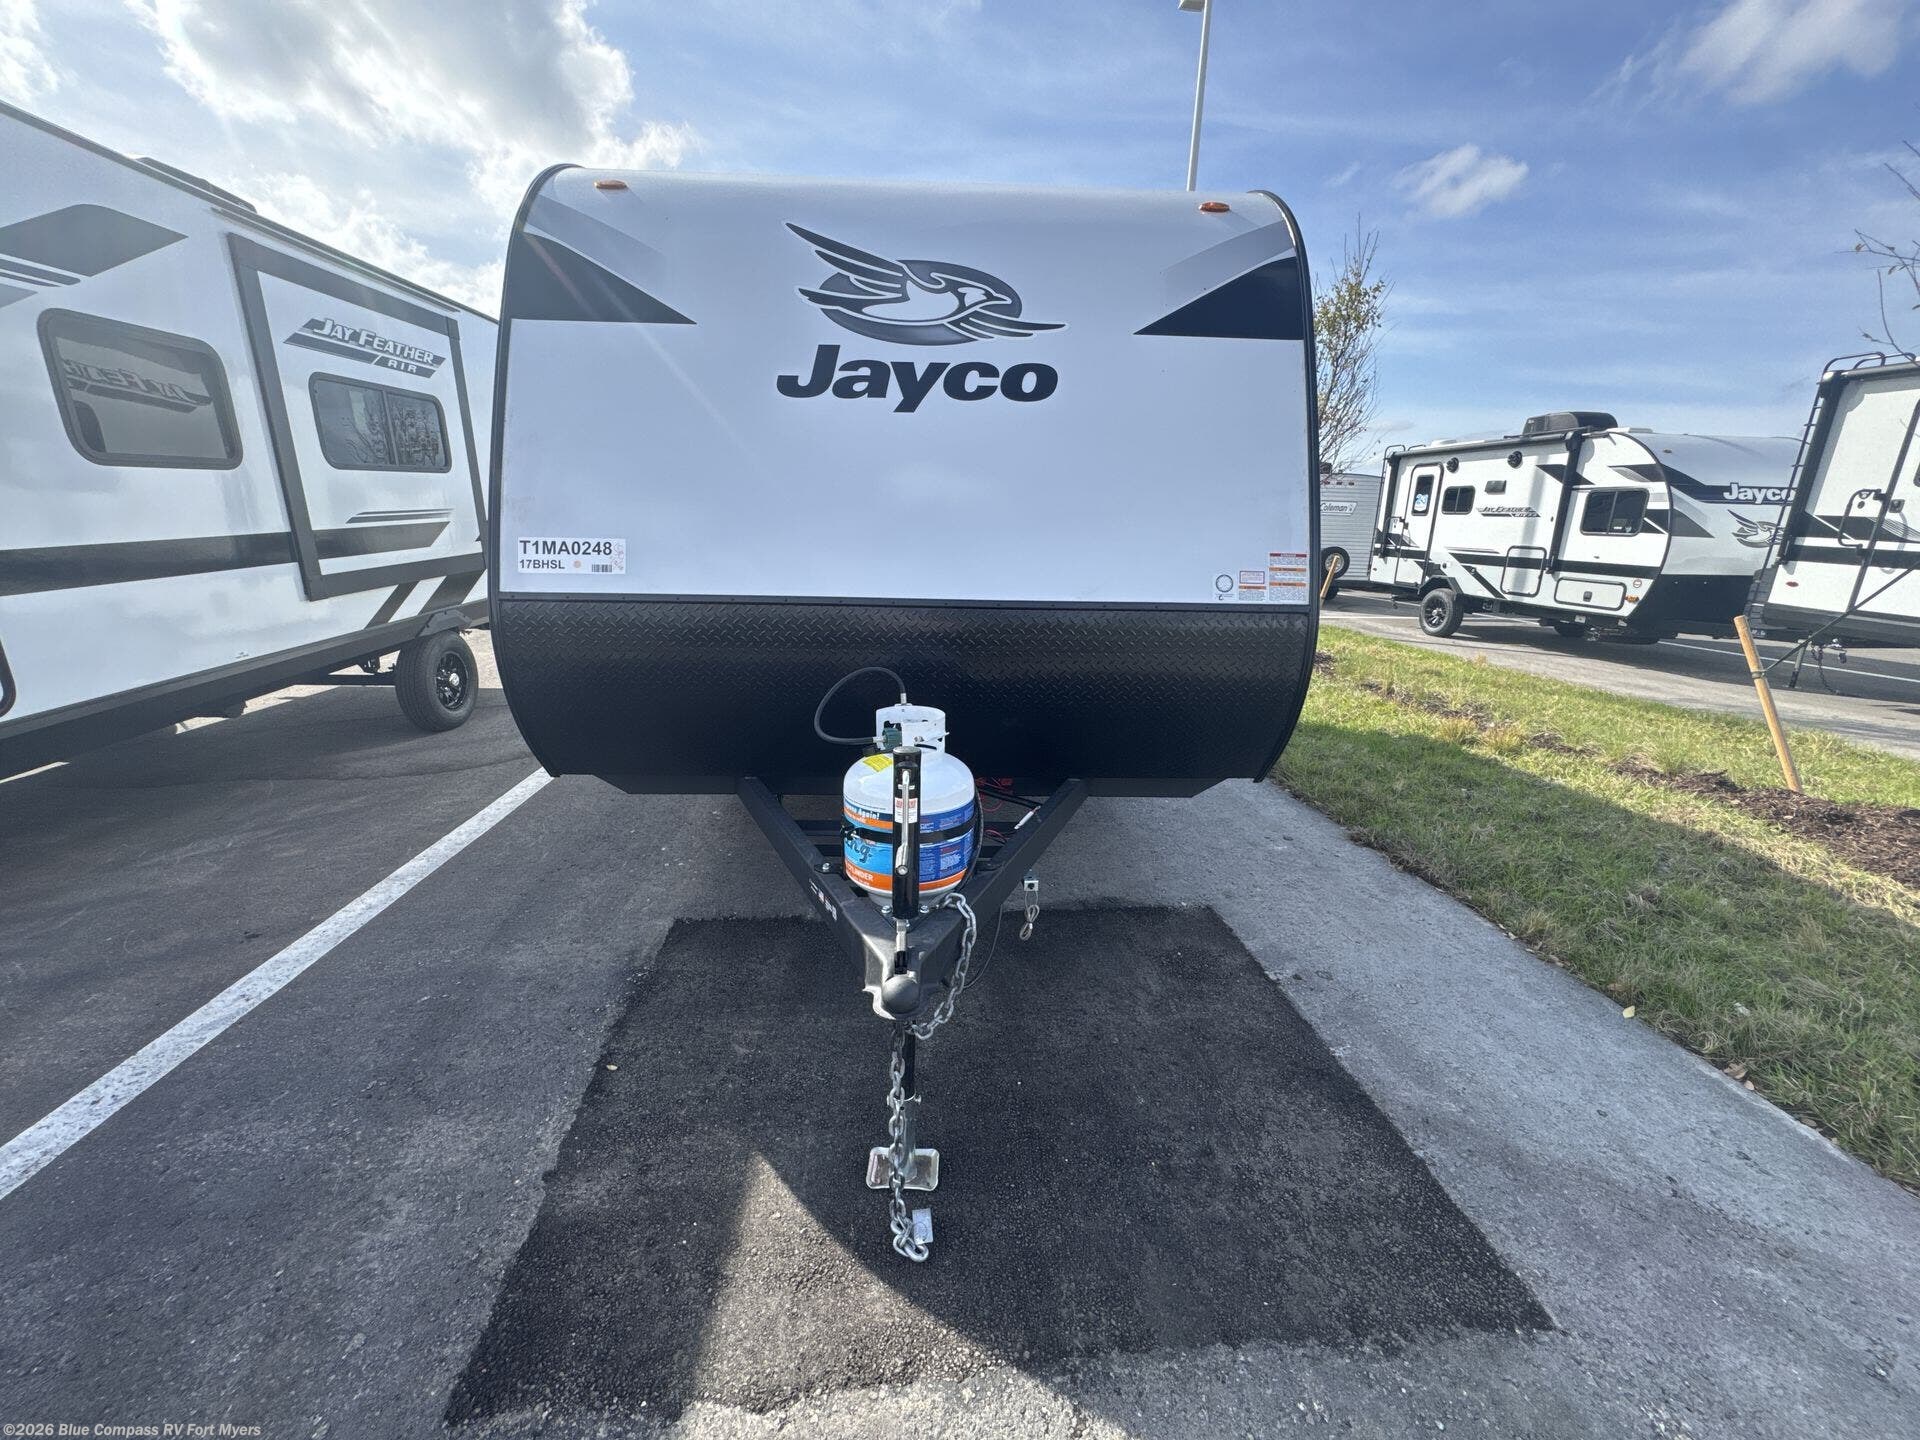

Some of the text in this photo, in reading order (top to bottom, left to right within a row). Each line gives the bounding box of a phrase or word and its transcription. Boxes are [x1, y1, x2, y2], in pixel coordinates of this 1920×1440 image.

[313, 318, 434, 365] JAY FEATHER
[387, 358, 418, 374] AIR
[776, 344, 1058, 413] Jayco
[1722, 482, 1797, 505] Jayco
[519, 540, 613, 556] T1MA0248
[519, 559, 566, 570] 17BHSL
